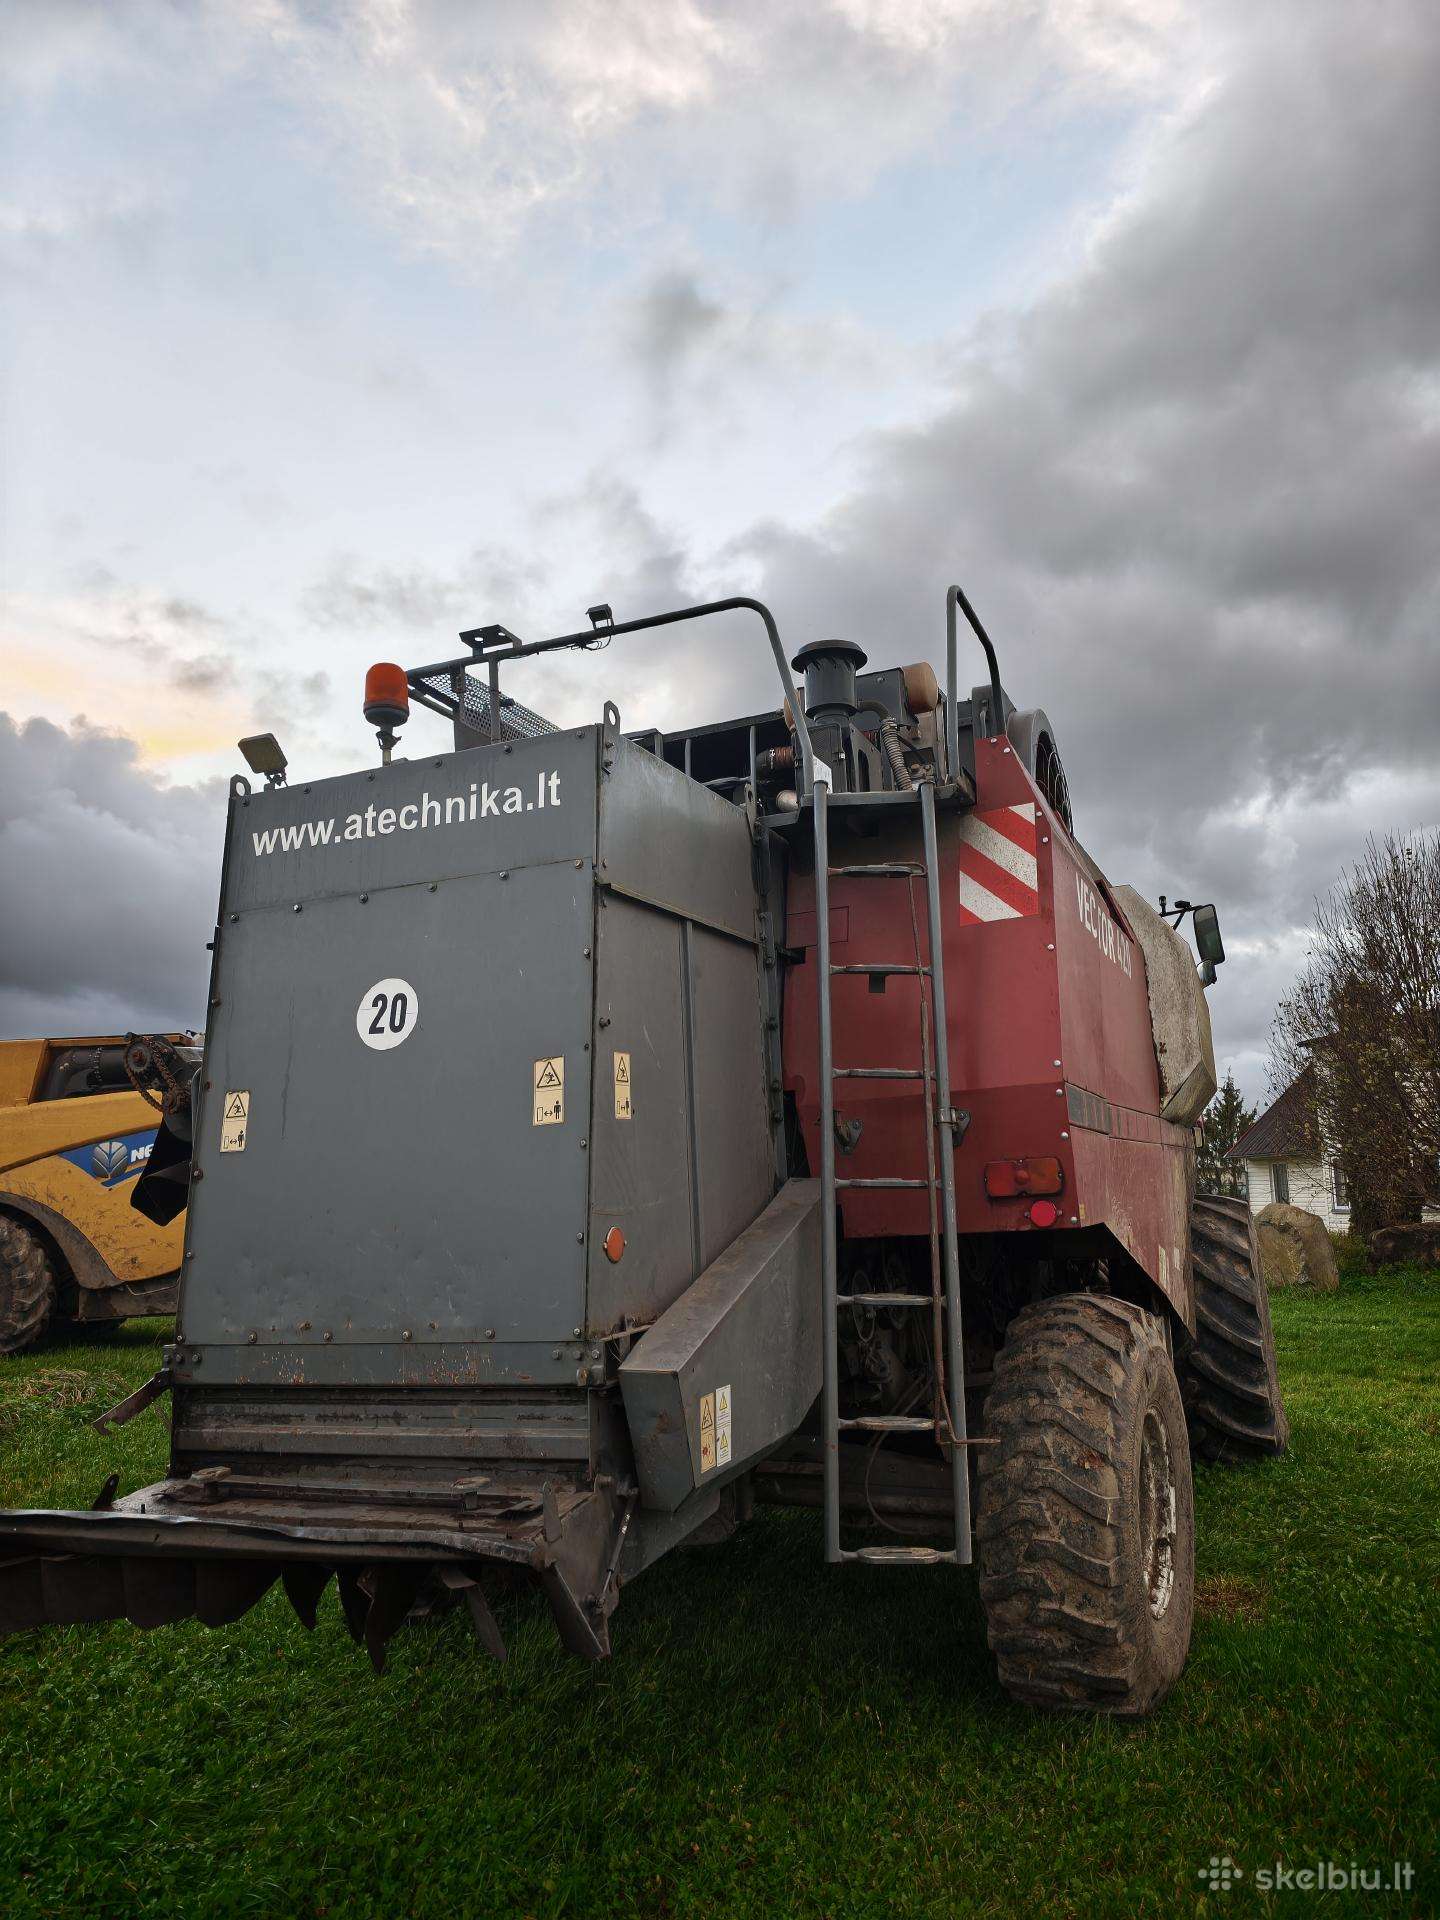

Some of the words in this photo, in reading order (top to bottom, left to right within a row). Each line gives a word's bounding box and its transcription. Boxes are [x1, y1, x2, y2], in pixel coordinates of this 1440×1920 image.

[252, 769, 562, 857] www.atechnika.lt
[1075, 871, 1117, 964] VECTOR
[368, 992, 409, 1035] 20
